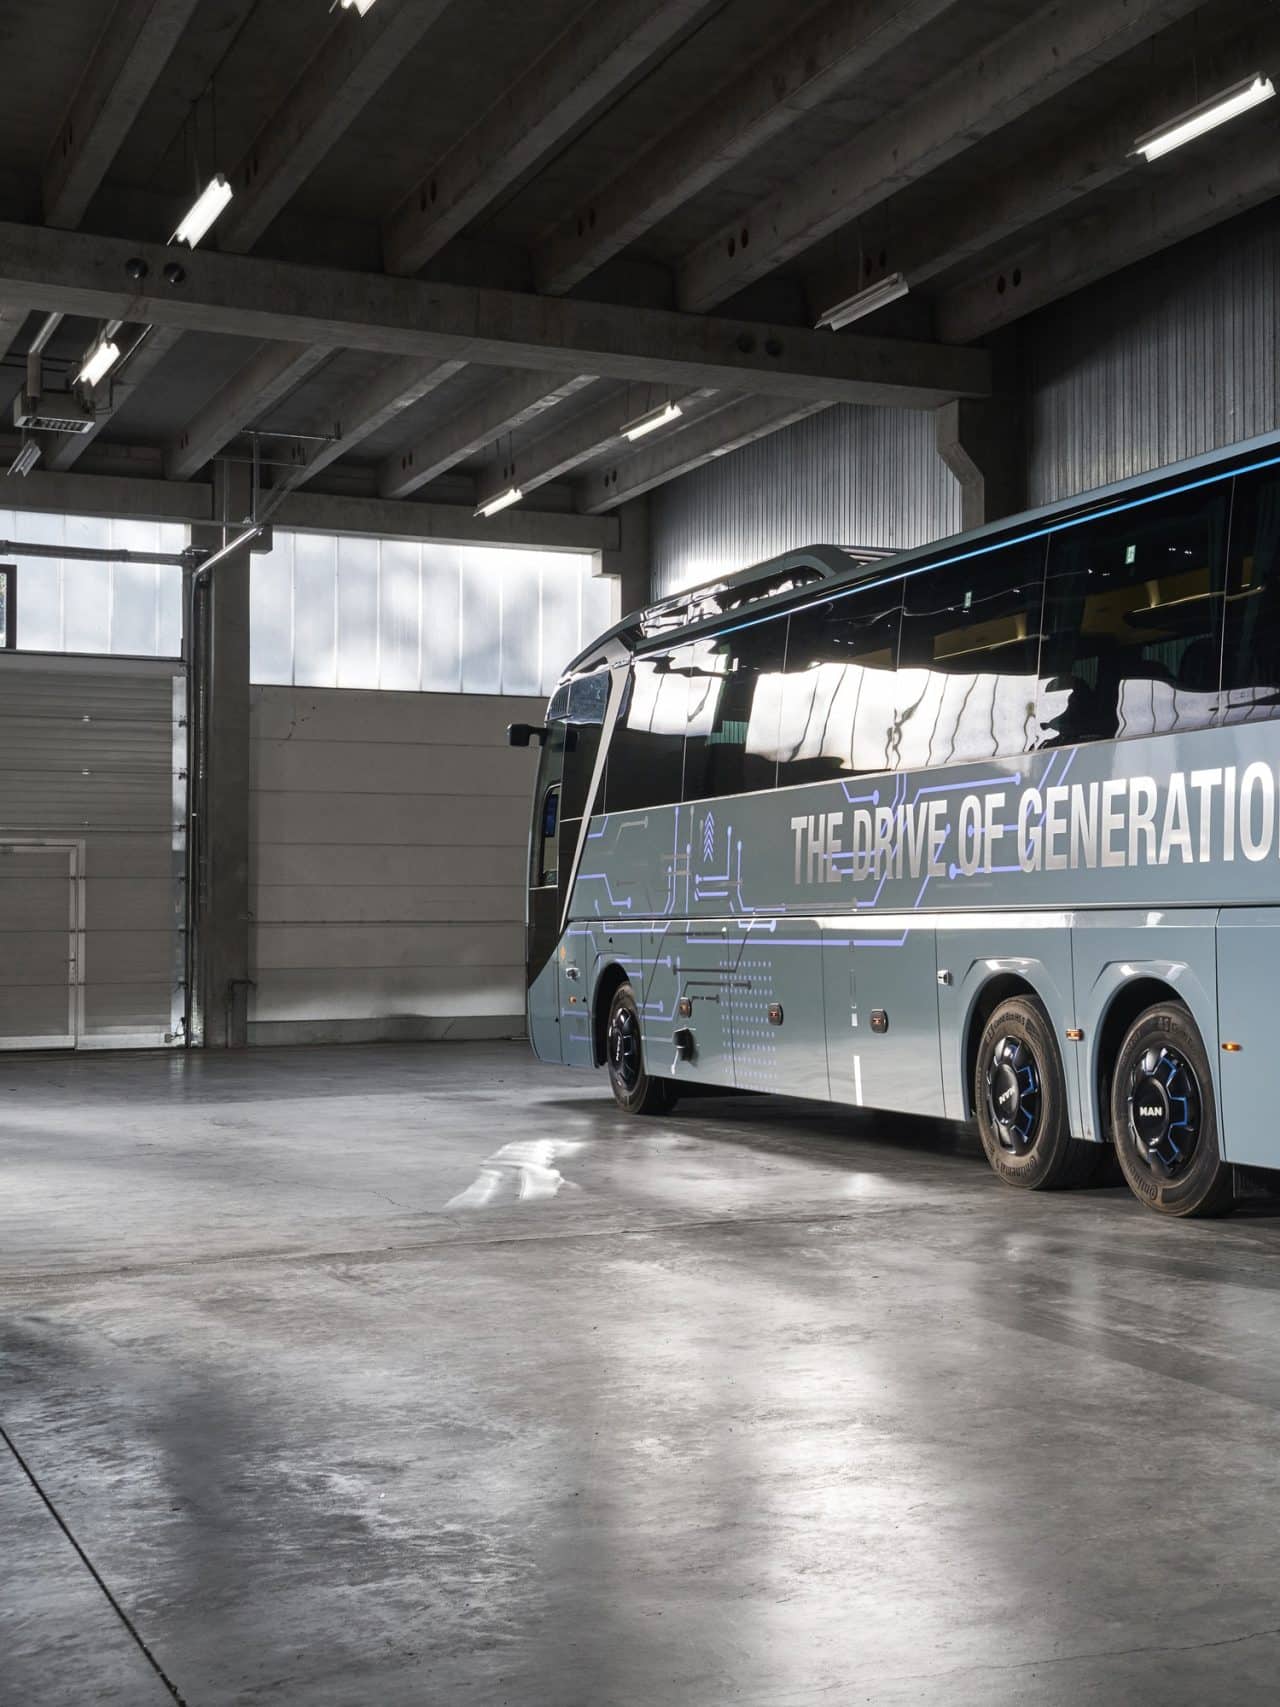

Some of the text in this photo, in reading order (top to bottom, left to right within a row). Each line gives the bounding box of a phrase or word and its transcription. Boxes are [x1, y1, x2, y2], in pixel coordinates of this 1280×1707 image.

[791, 812, 843, 885] THE
[853, 797, 948, 882] DRIVE
[959, 791, 1005, 878] OF
[1139, 1106, 1163, 1117] MAN
